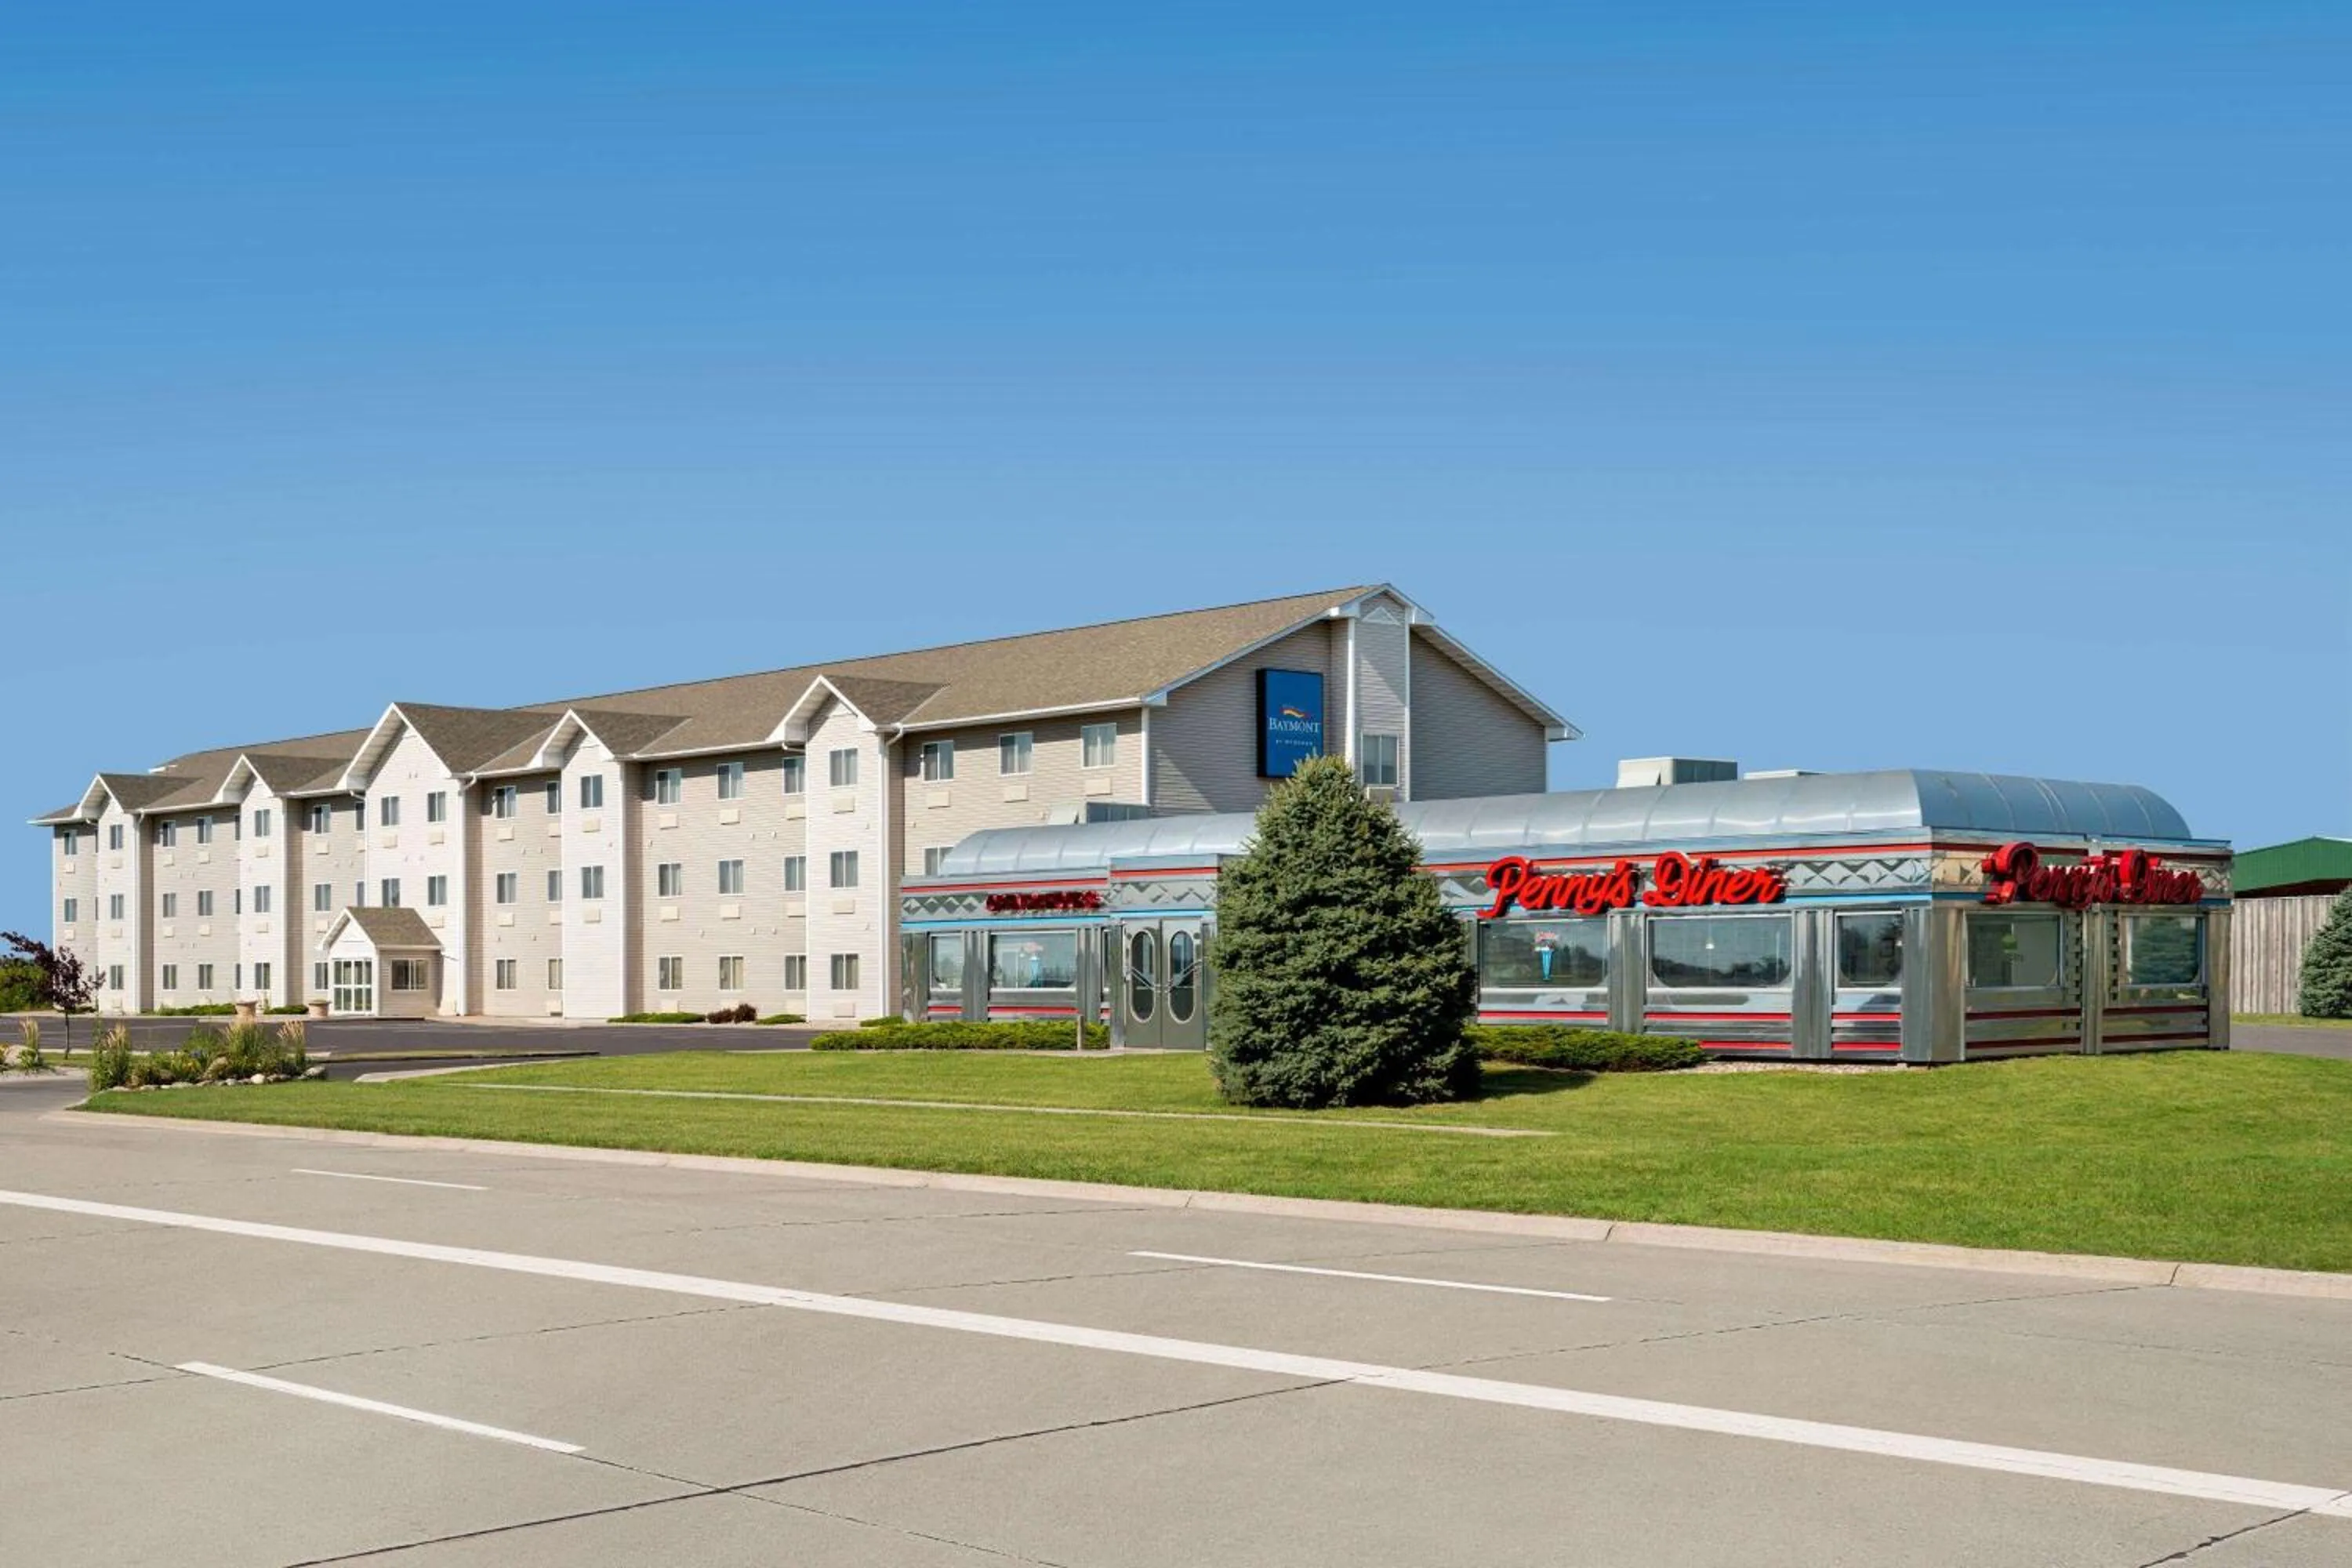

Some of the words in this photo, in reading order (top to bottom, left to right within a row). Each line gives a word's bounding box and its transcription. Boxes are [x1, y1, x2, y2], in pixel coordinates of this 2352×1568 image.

[1269, 717, 1321, 733] BAYMONT
[1476, 856, 1635, 918] Penny's
[1643, 851, 1780, 906] Diner
